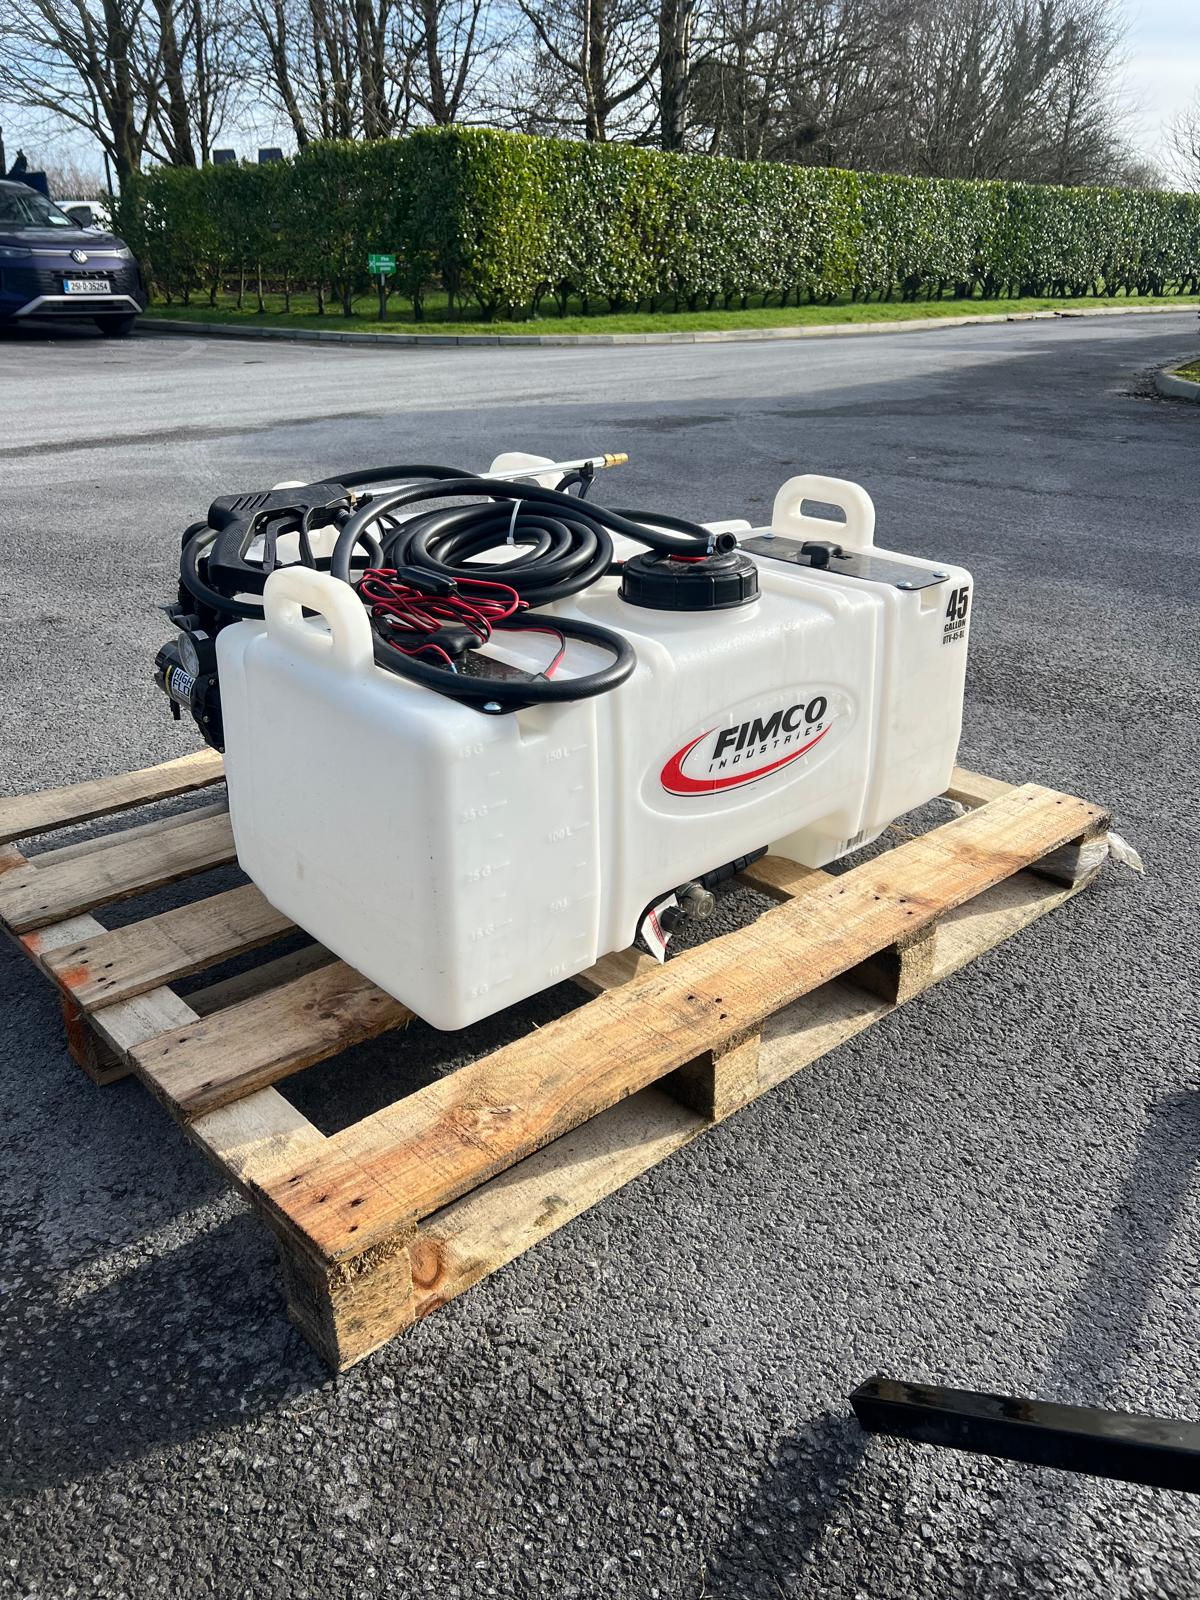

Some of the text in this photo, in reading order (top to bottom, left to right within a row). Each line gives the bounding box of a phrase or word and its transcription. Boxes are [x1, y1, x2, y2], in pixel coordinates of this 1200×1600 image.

[946, 586, 969, 621] 45
[944, 618, 967, 633] GALLON
[174, 669, 192, 688] HIGH
[712, 696, 828, 760] FIMCO
[709, 722, 824, 773] INDUSTRIES
